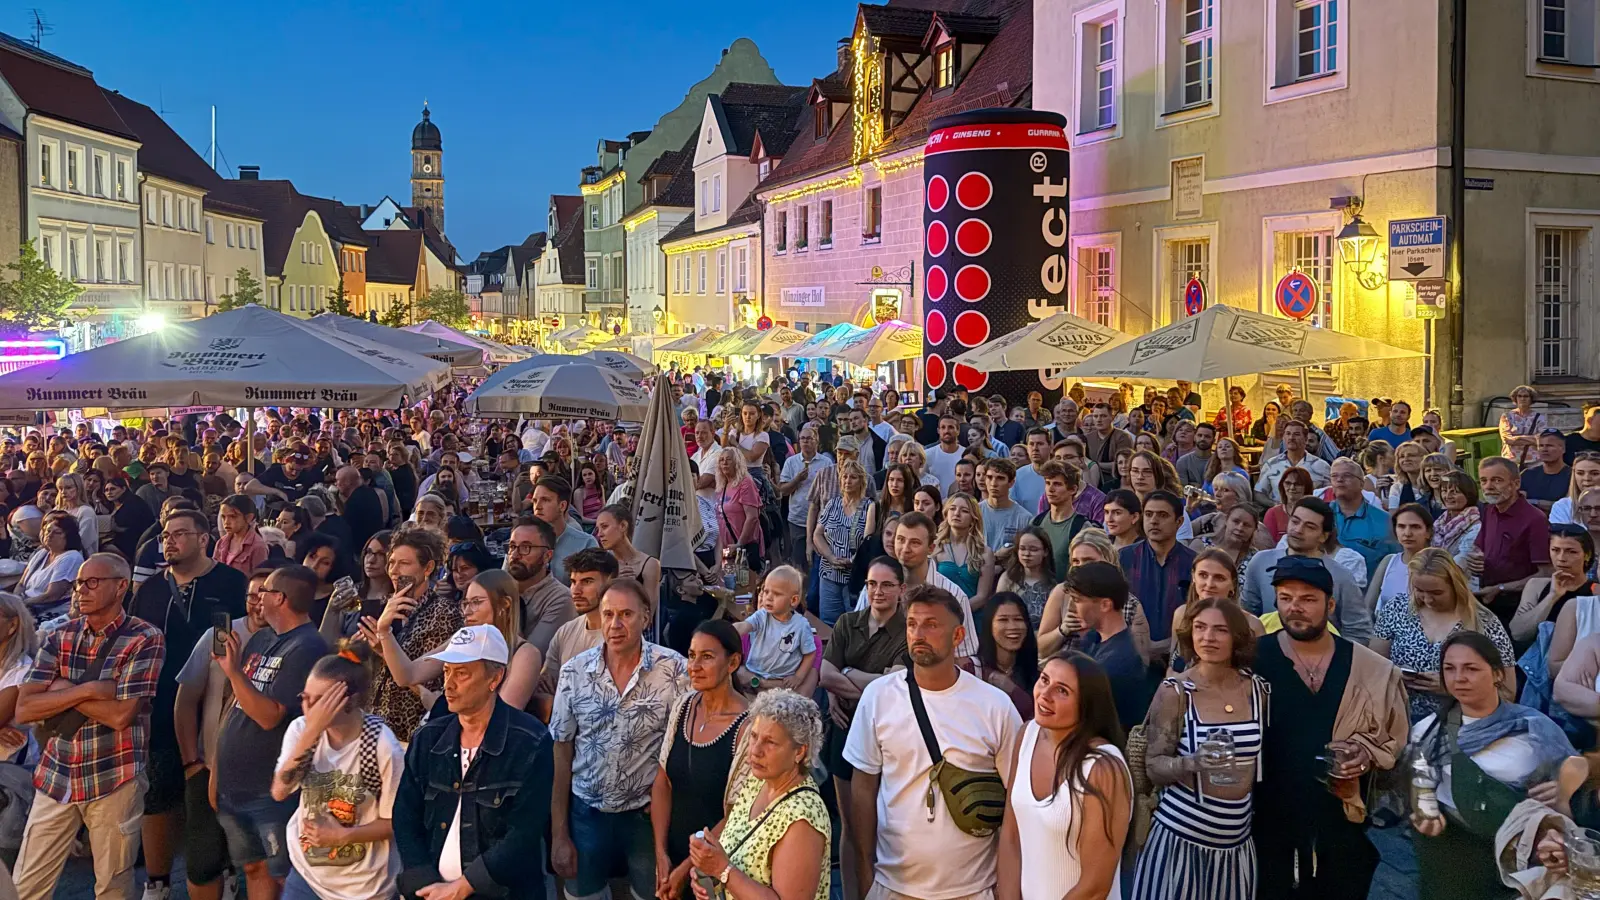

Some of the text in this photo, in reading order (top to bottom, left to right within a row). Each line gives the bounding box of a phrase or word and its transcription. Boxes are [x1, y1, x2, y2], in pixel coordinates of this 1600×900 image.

[952, 129, 991, 139] GINSENG
[1391, 221, 1442, 234] PARKSCHEIN-
[1398, 233, 1434, 245] AUTOMAT
[1391, 247, 1442, 256] Hier Parkschein
[811, 289, 822, 303] Hof
[1048, 334, 1102, 343] SALITOS
[1235, 327, 1297, 340] SALITOS
[1144, 335, 1191, 346] SALITOS
[108, 387, 148, 400] Bräu
[321, 388, 358, 402] Bräu
[589, 407, 611, 418] Bräu
